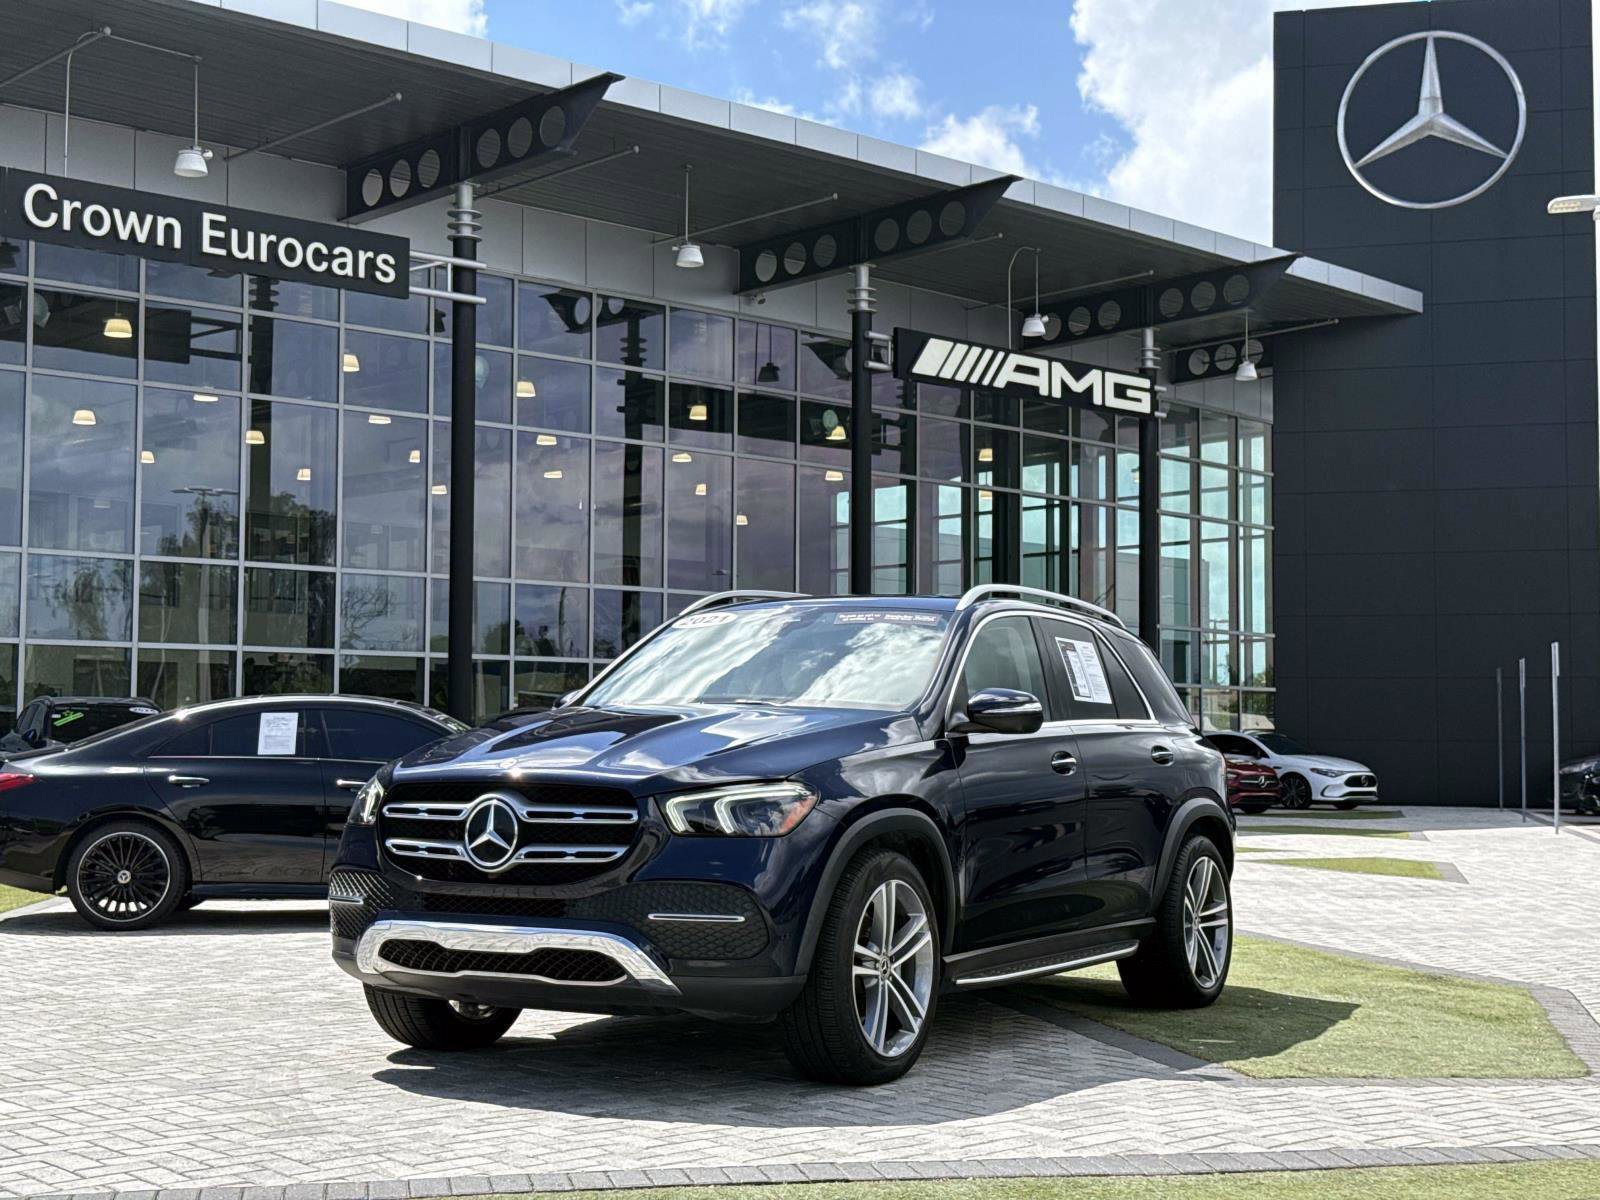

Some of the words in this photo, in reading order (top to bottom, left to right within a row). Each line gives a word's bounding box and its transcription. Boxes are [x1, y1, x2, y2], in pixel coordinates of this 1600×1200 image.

[23, 183, 182, 249] Crown
[201, 211, 397, 284] Eurocars
[993, 352, 1151, 414] AMG
[679, 614, 731, 626] 2021
